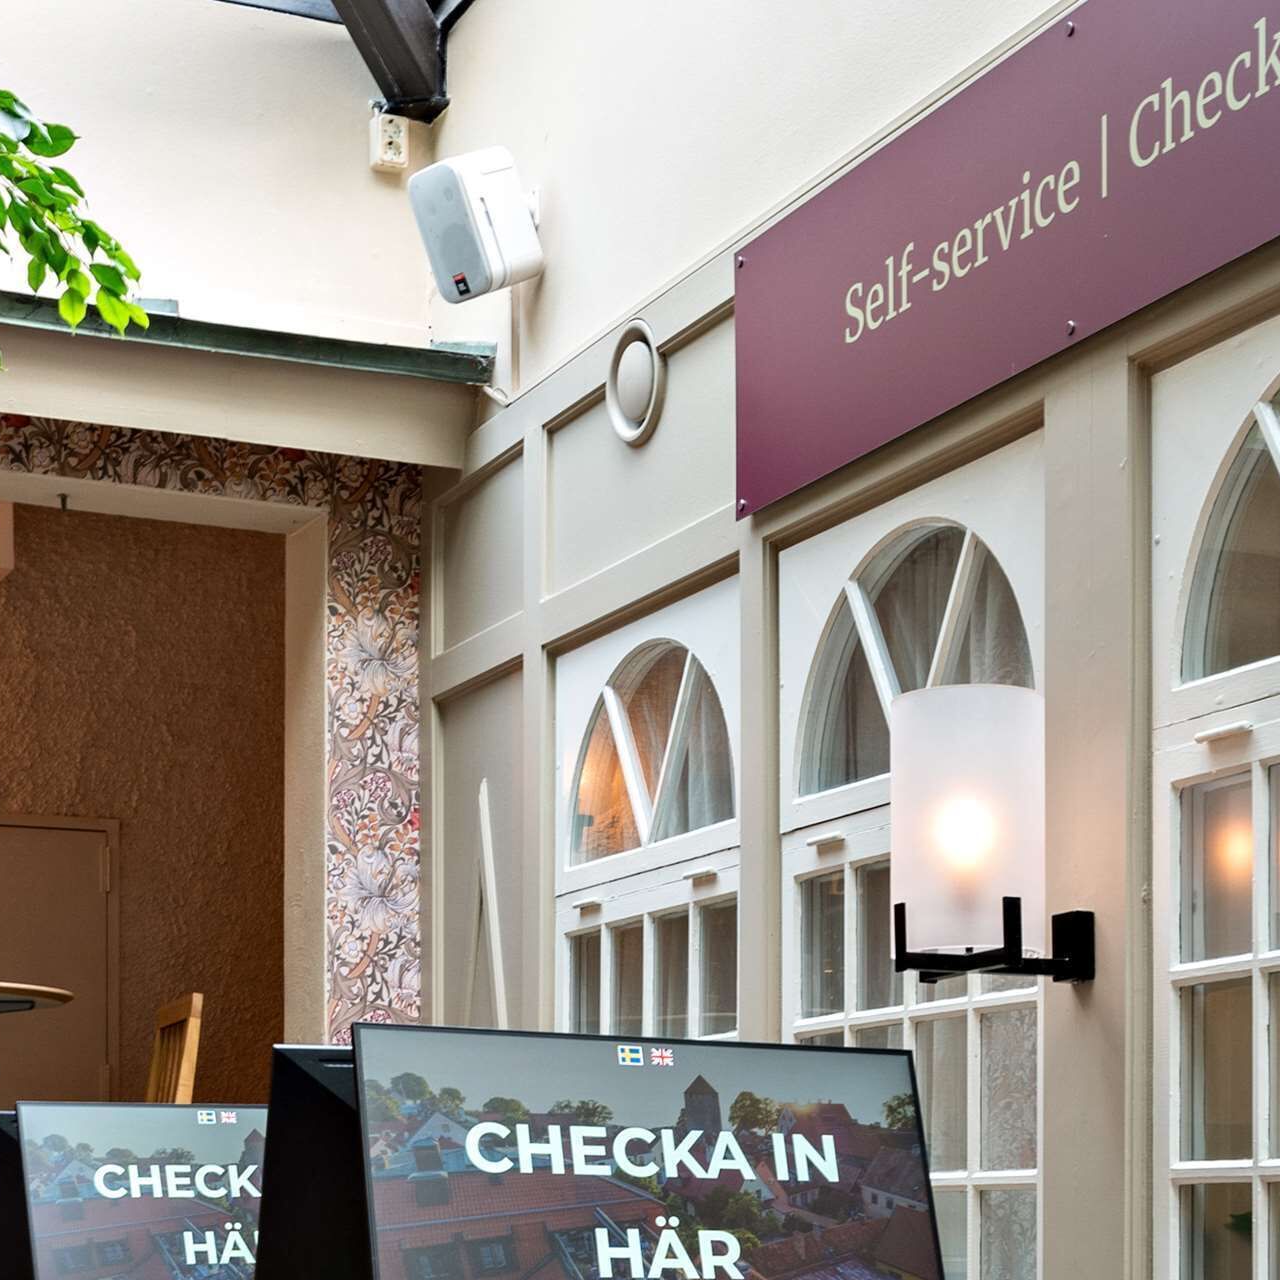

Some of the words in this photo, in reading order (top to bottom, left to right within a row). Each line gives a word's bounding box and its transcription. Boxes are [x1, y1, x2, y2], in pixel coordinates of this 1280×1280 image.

[843, 159, 1081, 344] Self-service
[464, 1120, 757, 1182] CHECKA
[771, 1131, 840, 1183] IN
[183, 1221, 260, 1266] HÄ
[594, 1215, 746, 1280] HÄR
